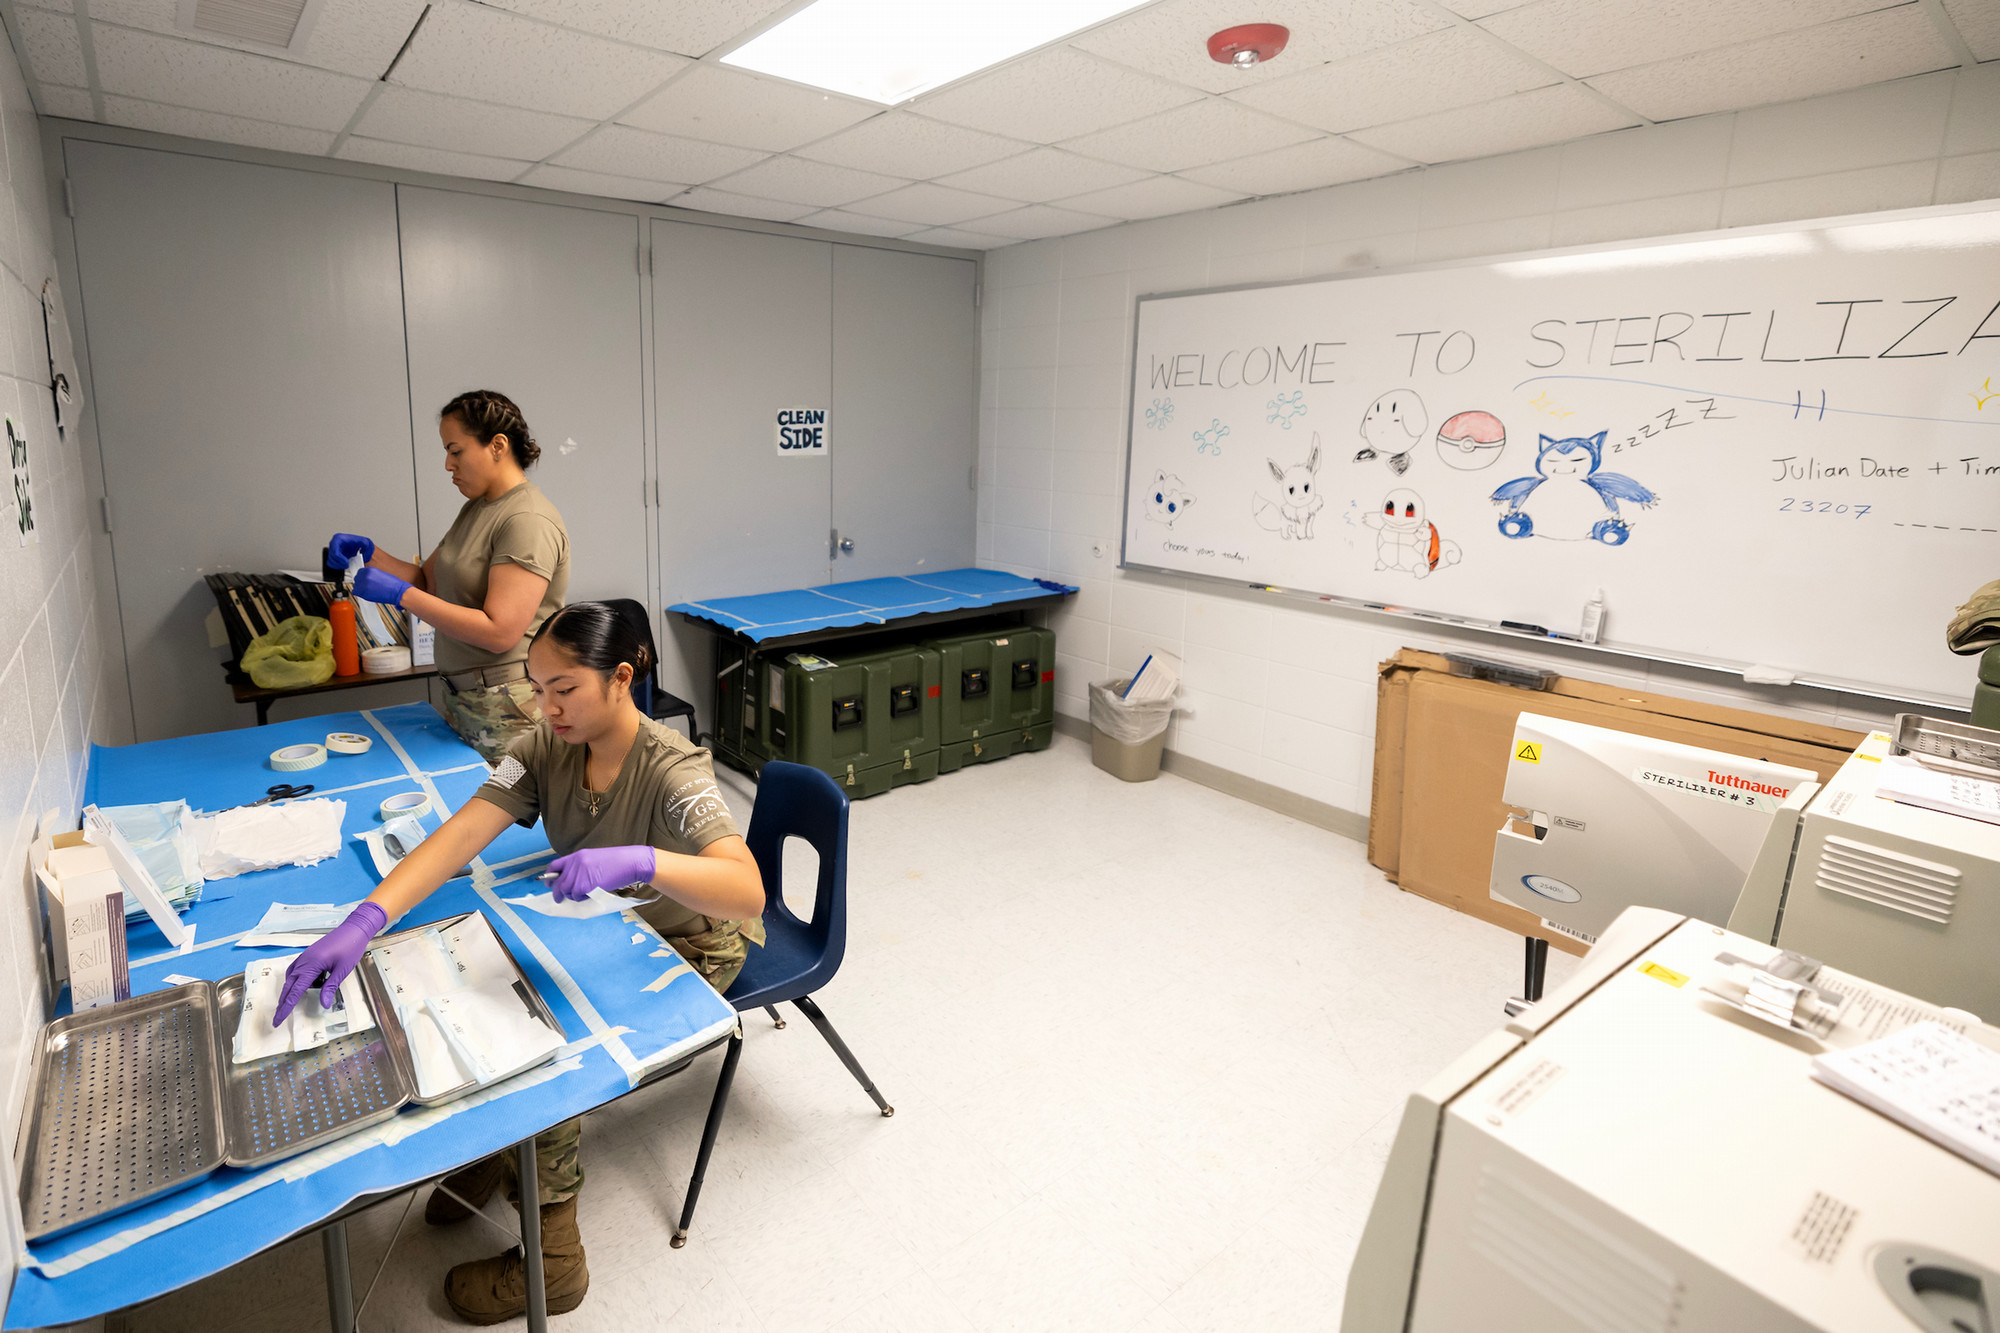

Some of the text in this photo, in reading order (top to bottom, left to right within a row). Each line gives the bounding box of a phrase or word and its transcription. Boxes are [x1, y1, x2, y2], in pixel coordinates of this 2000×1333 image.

[1151, 342, 1347, 390] WELCOME
[1395, 330, 1476, 378] TO
[777, 410, 825, 426] CLEAN
[779, 426, 823, 450] SIDE
[1771, 456, 1850, 482] Julian
[1860, 457, 1910, 479] Date
[1959, 456, 2000, 476] Tim
[1779, 497, 1872, 520] 23207
[1642, 771, 1726, 798] STERILIZER
[1746, 796, 1755, 806] 3
[1707, 770, 1790, 799] Tuttnauer
[694, 799, 718, 816] GS
